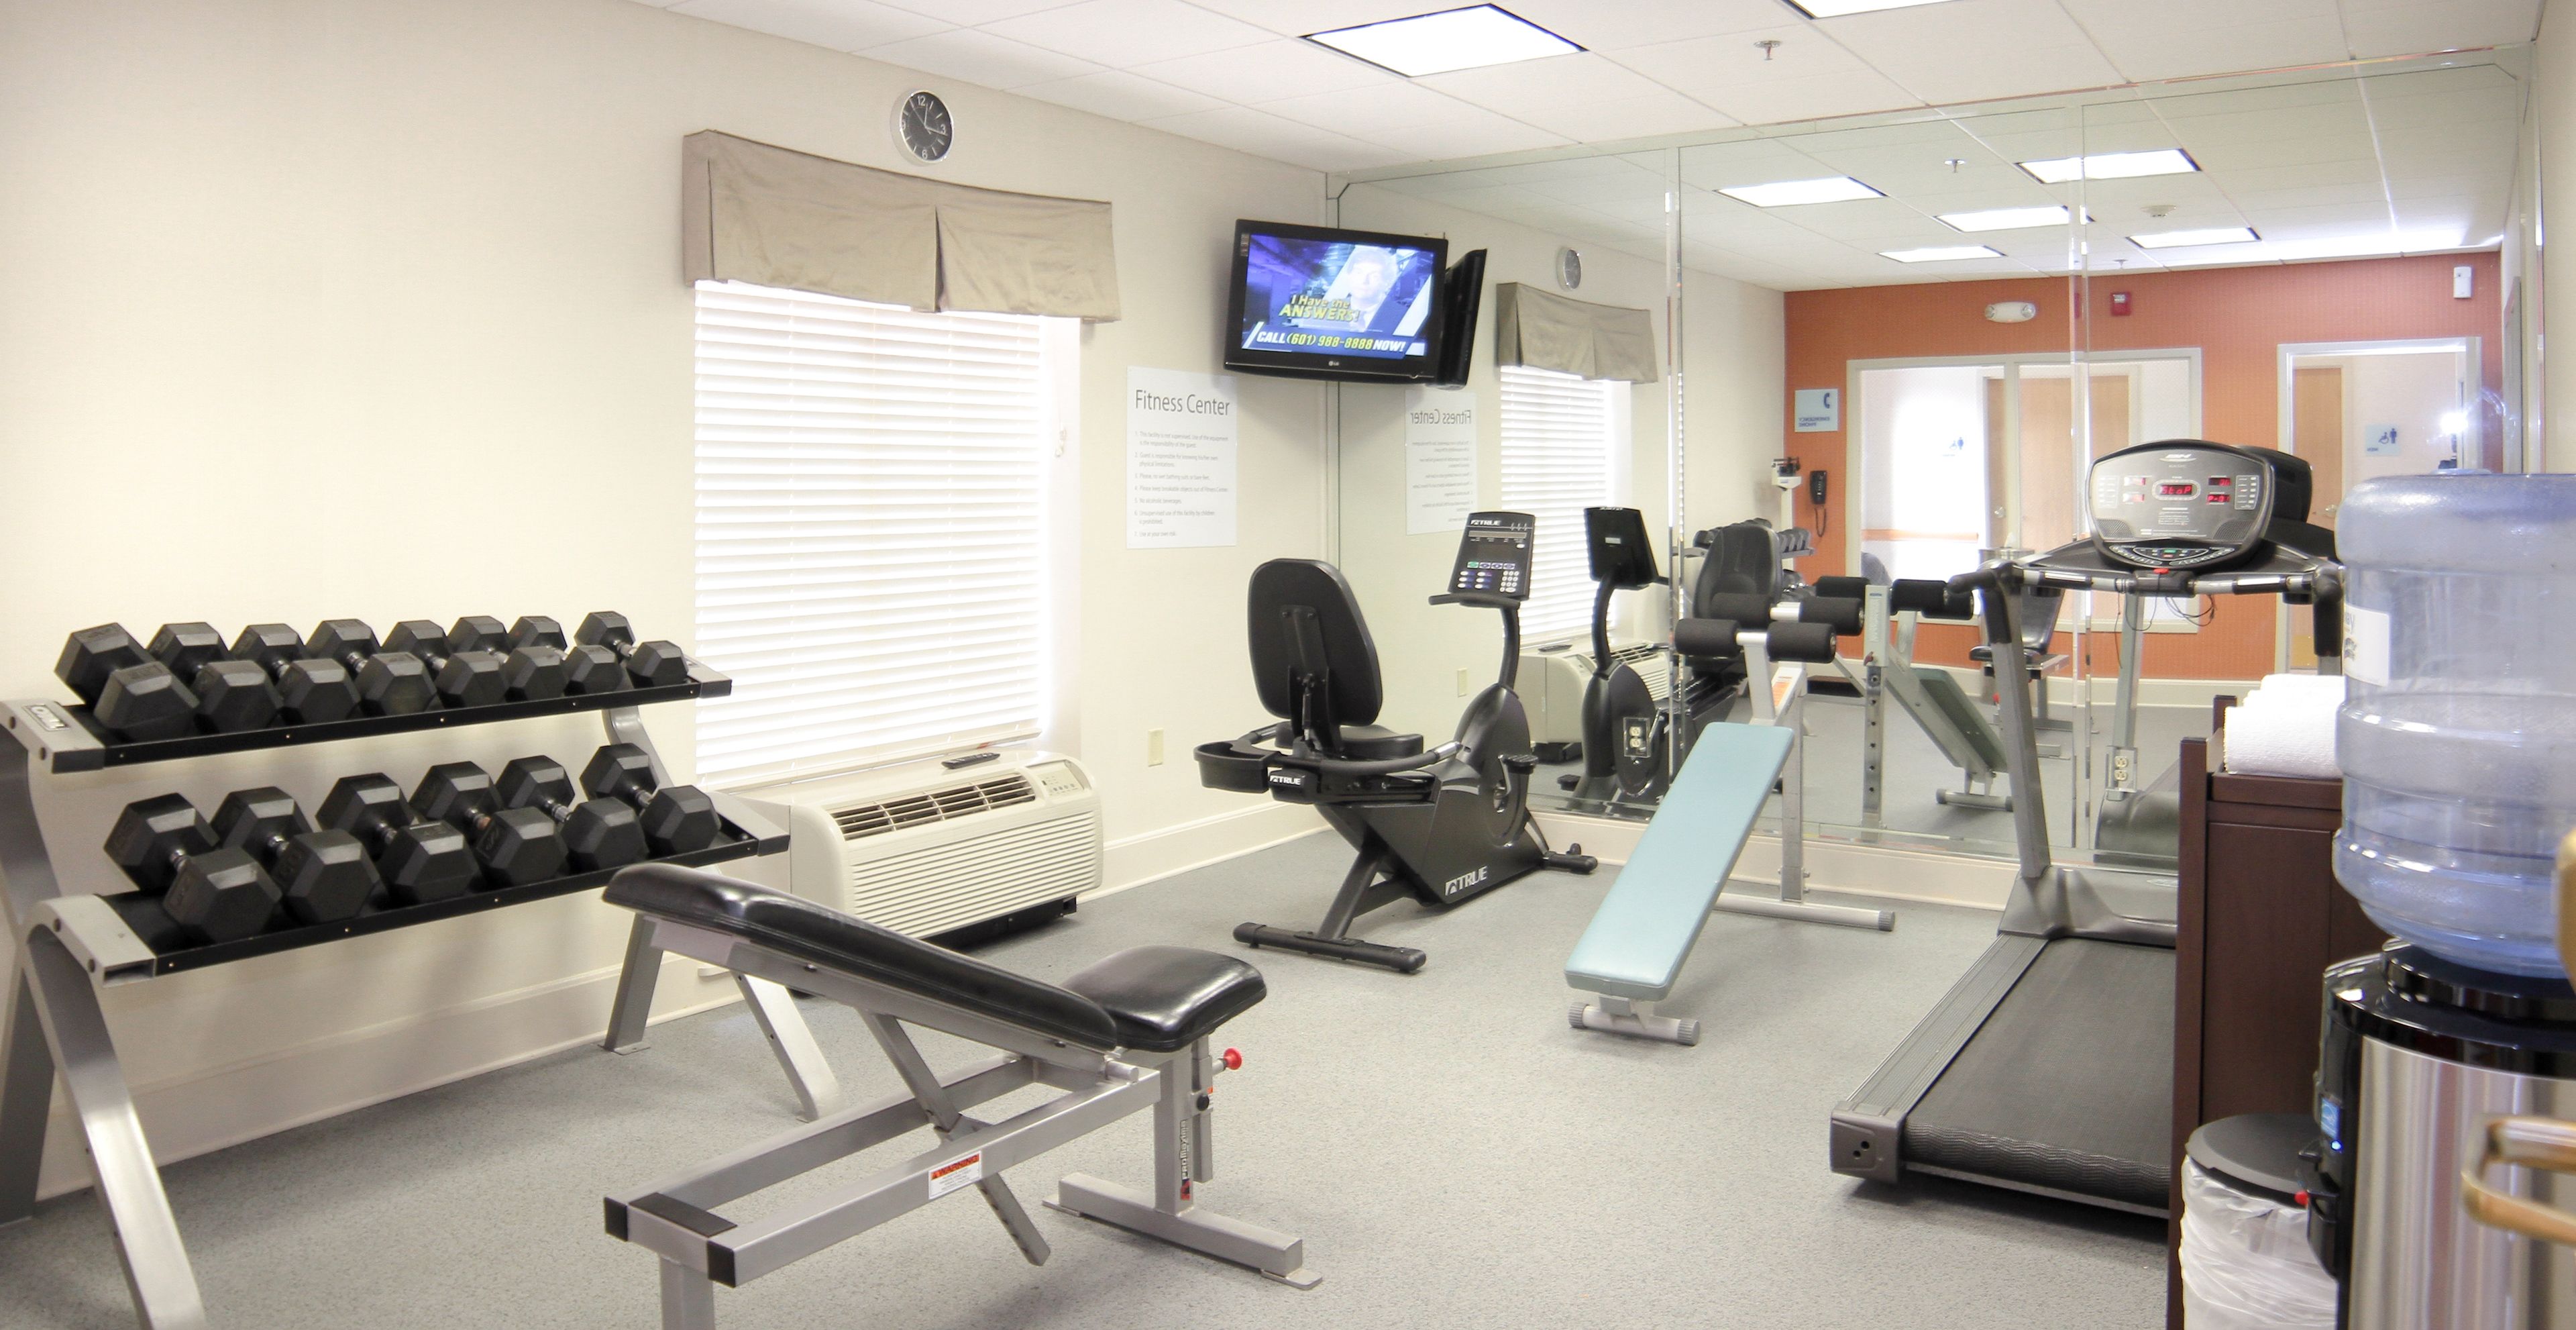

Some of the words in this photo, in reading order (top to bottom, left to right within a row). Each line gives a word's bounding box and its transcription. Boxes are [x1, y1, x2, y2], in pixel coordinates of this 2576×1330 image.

[917, 95, 926, 107] 12
[941, 124, 947, 134] 3
[922, 150, 928, 160] 6
[1291, 294, 1297, 305] I
[1298, 295, 1329, 307] Have
[1331, 299, 1350, 309] the
[1278, 303, 1360, 322] ANSWERS!
[1256, 331, 1286, 344] CALL
[1373, 339, 1407, 352] NOW!
[1135, 389, 1183, 413] Fitness
[1186, 394, 1230, 416] Center
[1278, 776, 1301, 785] TRUE
[1456, 866, 1488, 890] TRUE
